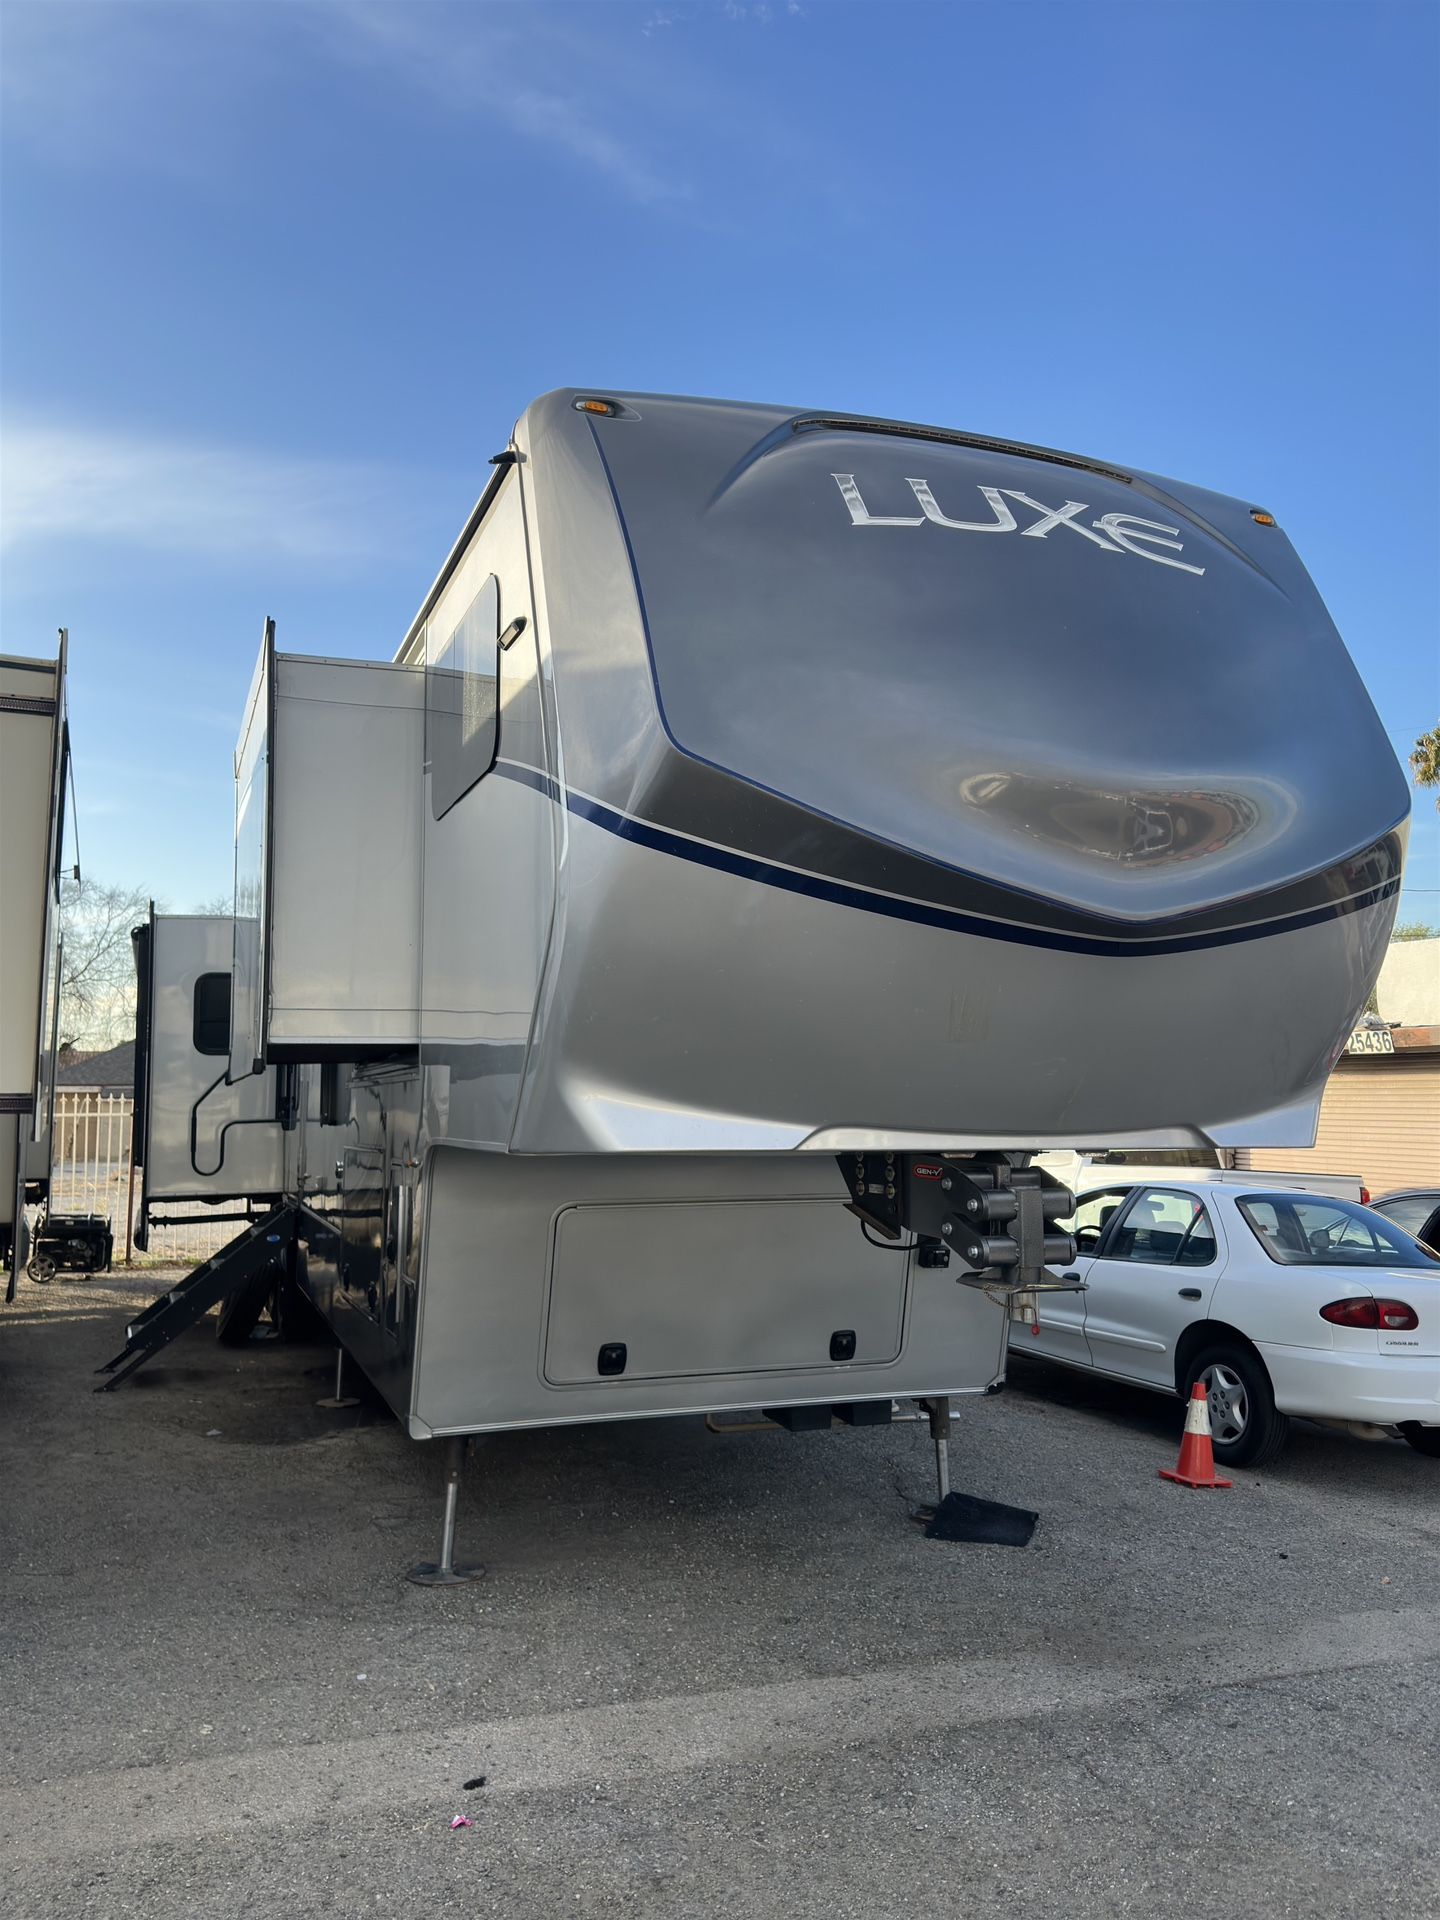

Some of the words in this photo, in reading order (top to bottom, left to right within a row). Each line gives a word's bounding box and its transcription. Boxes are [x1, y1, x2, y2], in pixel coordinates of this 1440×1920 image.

[831, 473, 1205, 575] LUXE
[1350, 1031, 1392, 1053] 25436
[917, 1167, 943, 1176] GEN-Y
